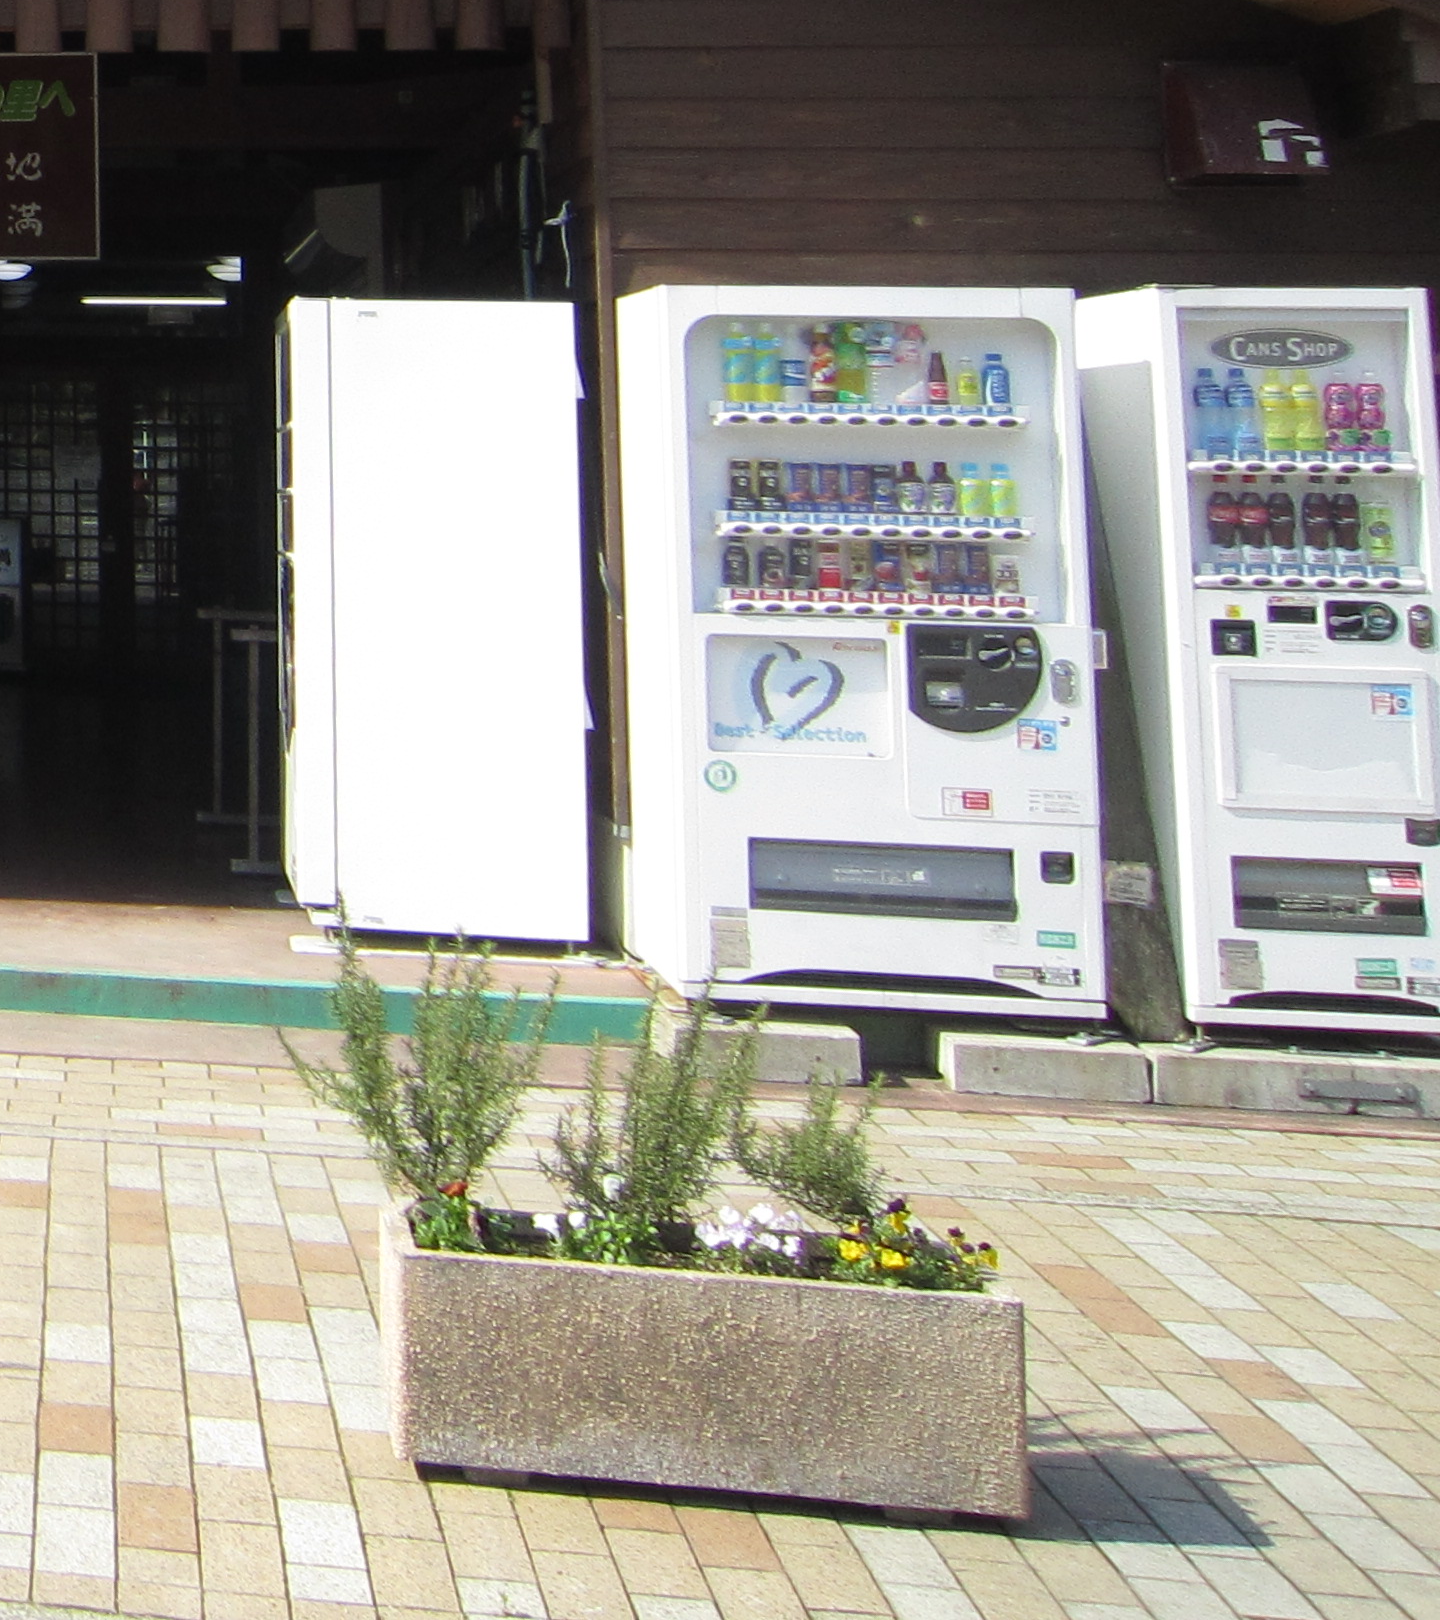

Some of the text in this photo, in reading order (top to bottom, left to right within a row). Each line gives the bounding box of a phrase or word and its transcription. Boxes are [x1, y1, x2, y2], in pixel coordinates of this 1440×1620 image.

[1229, 337, 1339, 362] CANS SHOP
[772, 724, 868, 745] Selection
